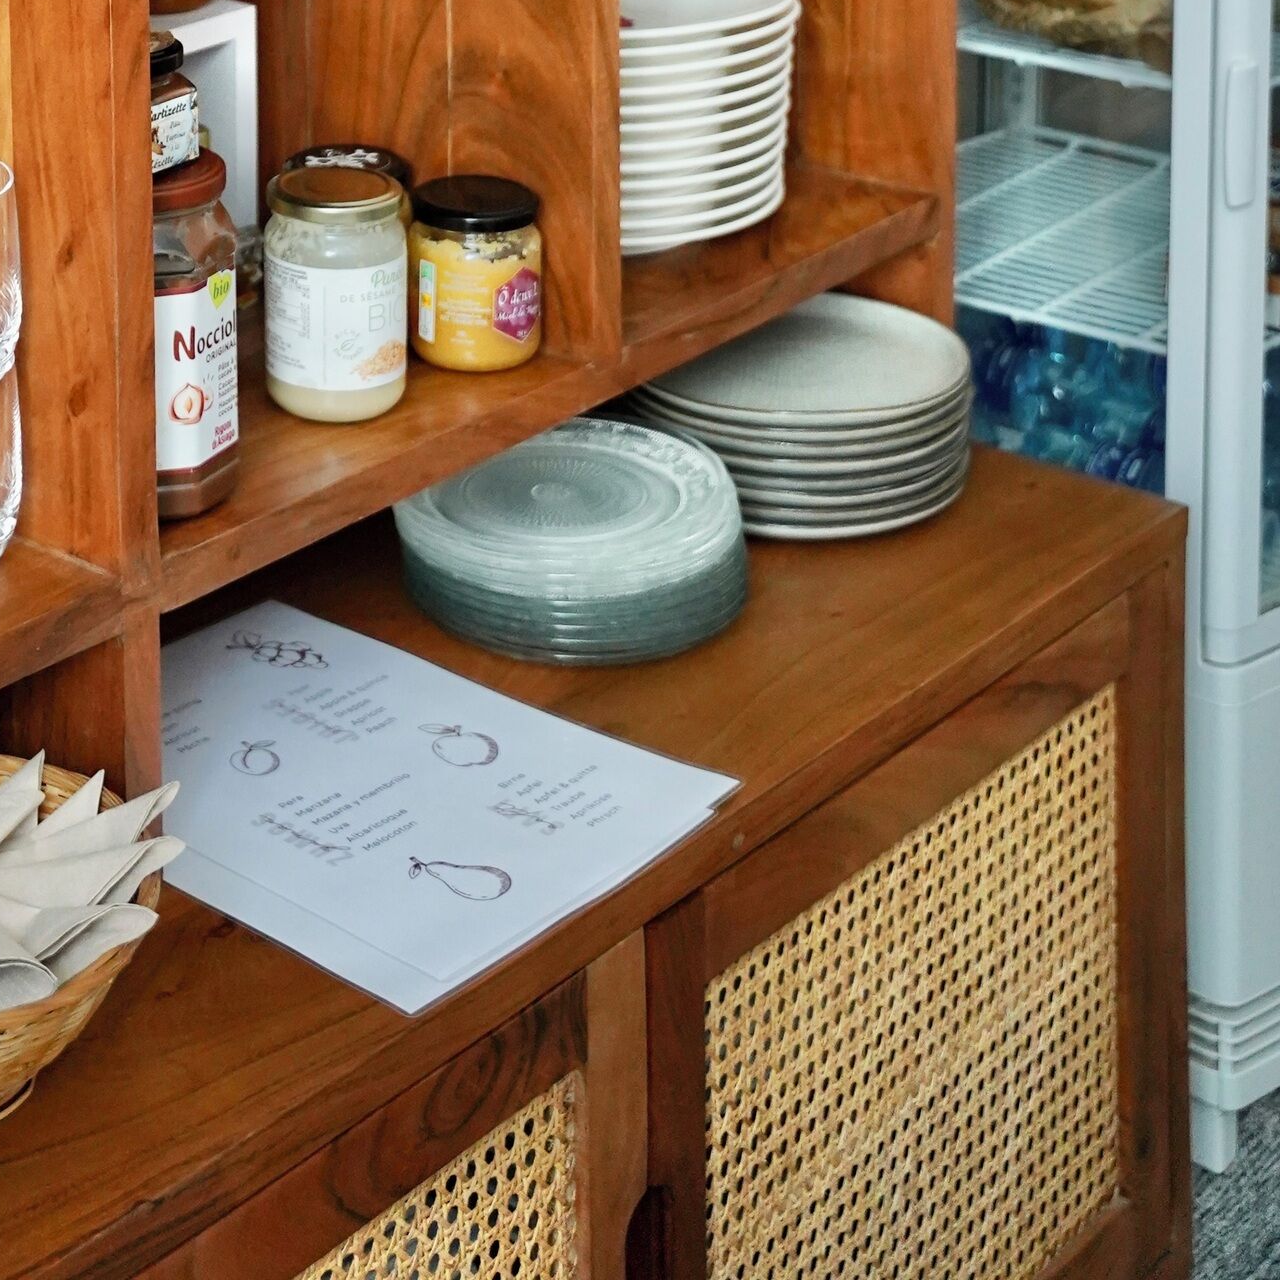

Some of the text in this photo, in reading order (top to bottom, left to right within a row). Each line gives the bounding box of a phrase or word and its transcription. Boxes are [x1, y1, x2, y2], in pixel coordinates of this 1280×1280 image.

[151, 102, 187, 122] artizette
[213, 279, 230, 300] bio
[340, 293, 355, 303] DE
[359, 772, 411, 801] membrillo
[497, 772, 526, 789] Birne
[278, 794, 305, 809] Pera
[294, 791, 342, 818] Manzana
[550, 791, 586, 811] Traube
[327, 821, 351, 835] Uva
[345, 808, 408, 843] Albaricoque
